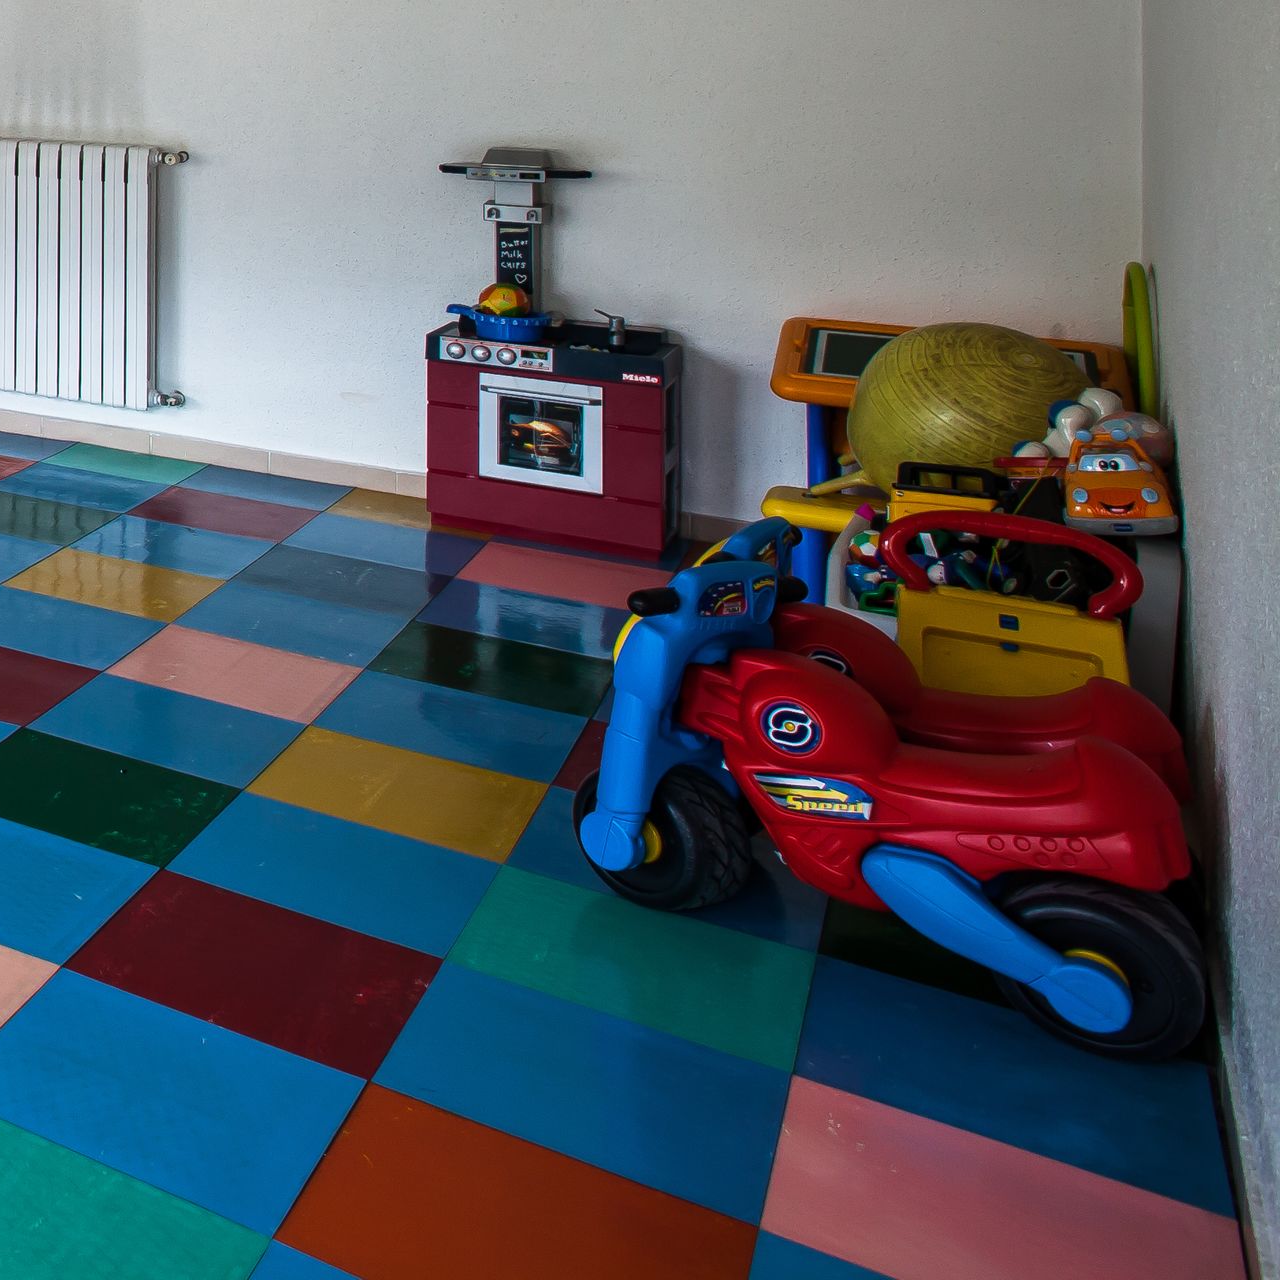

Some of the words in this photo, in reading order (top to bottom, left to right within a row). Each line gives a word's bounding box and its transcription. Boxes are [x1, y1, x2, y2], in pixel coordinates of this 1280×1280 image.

[500, 250, 523, 259] Milk
[622, 373, 659, 384] Miele
[787, 795, 864, 813] Speed
